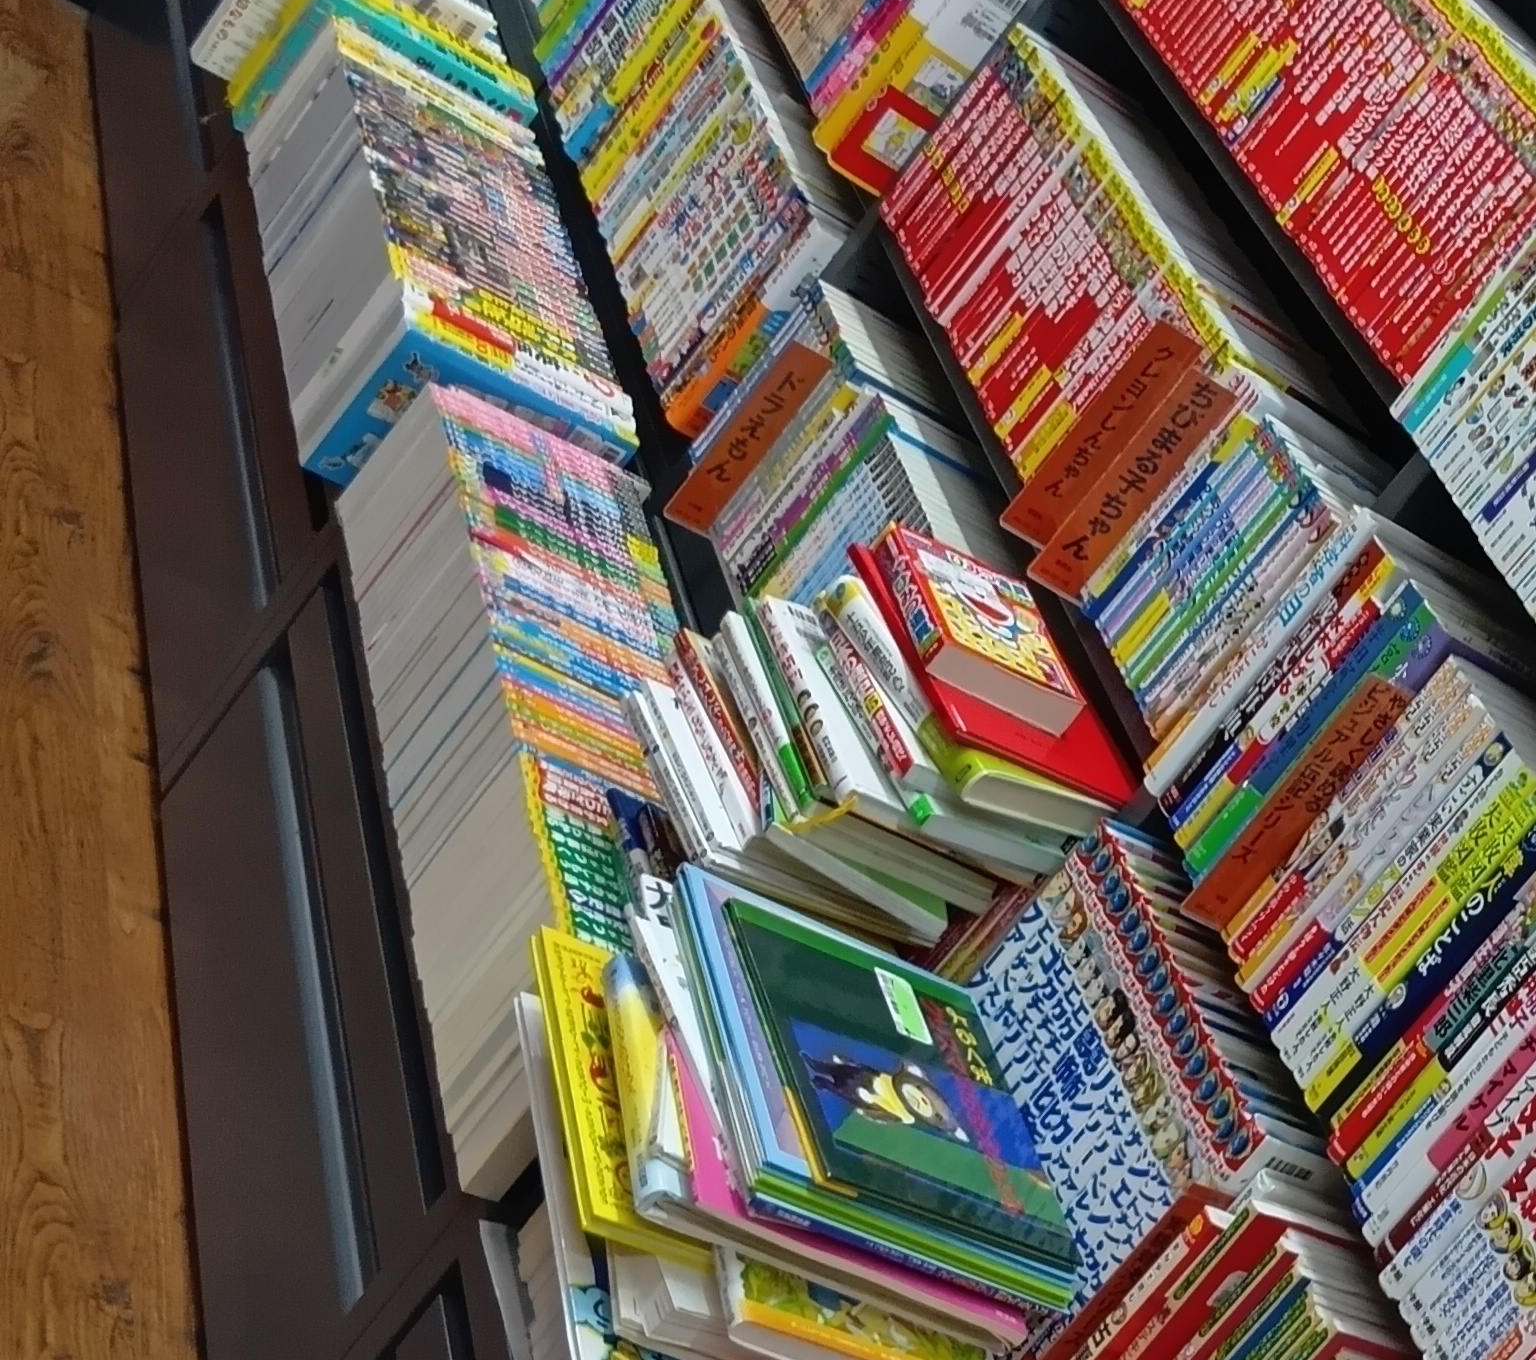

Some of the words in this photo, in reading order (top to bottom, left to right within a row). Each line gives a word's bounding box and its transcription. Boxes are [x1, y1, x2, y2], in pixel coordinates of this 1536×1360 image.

[1059, 378, 1222, 566] ちびまる子ちゃん
